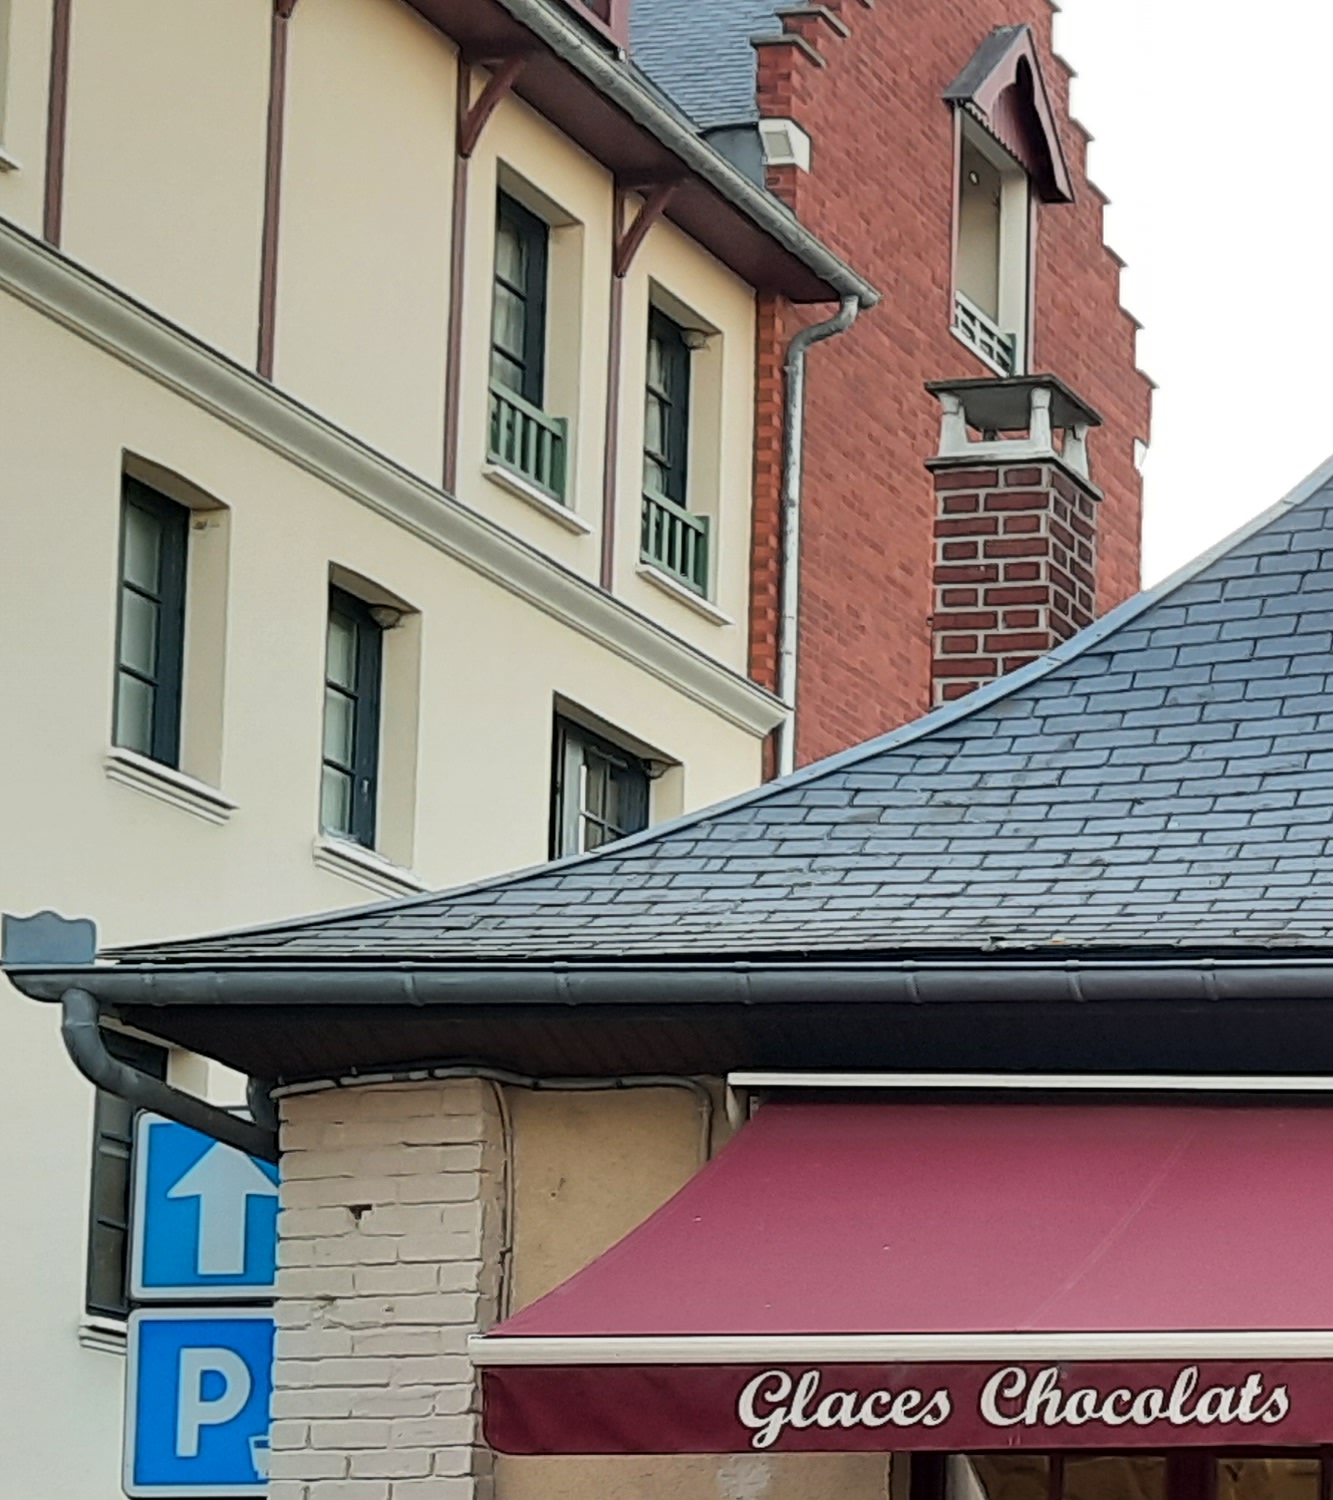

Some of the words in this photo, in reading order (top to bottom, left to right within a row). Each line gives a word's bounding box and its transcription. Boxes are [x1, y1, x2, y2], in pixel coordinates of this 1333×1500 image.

[175, 1347, 252, 1458] P
[738, 1370, 951, 1448] Glaces
[980, 1365, 1289, 1427] Chocolats
